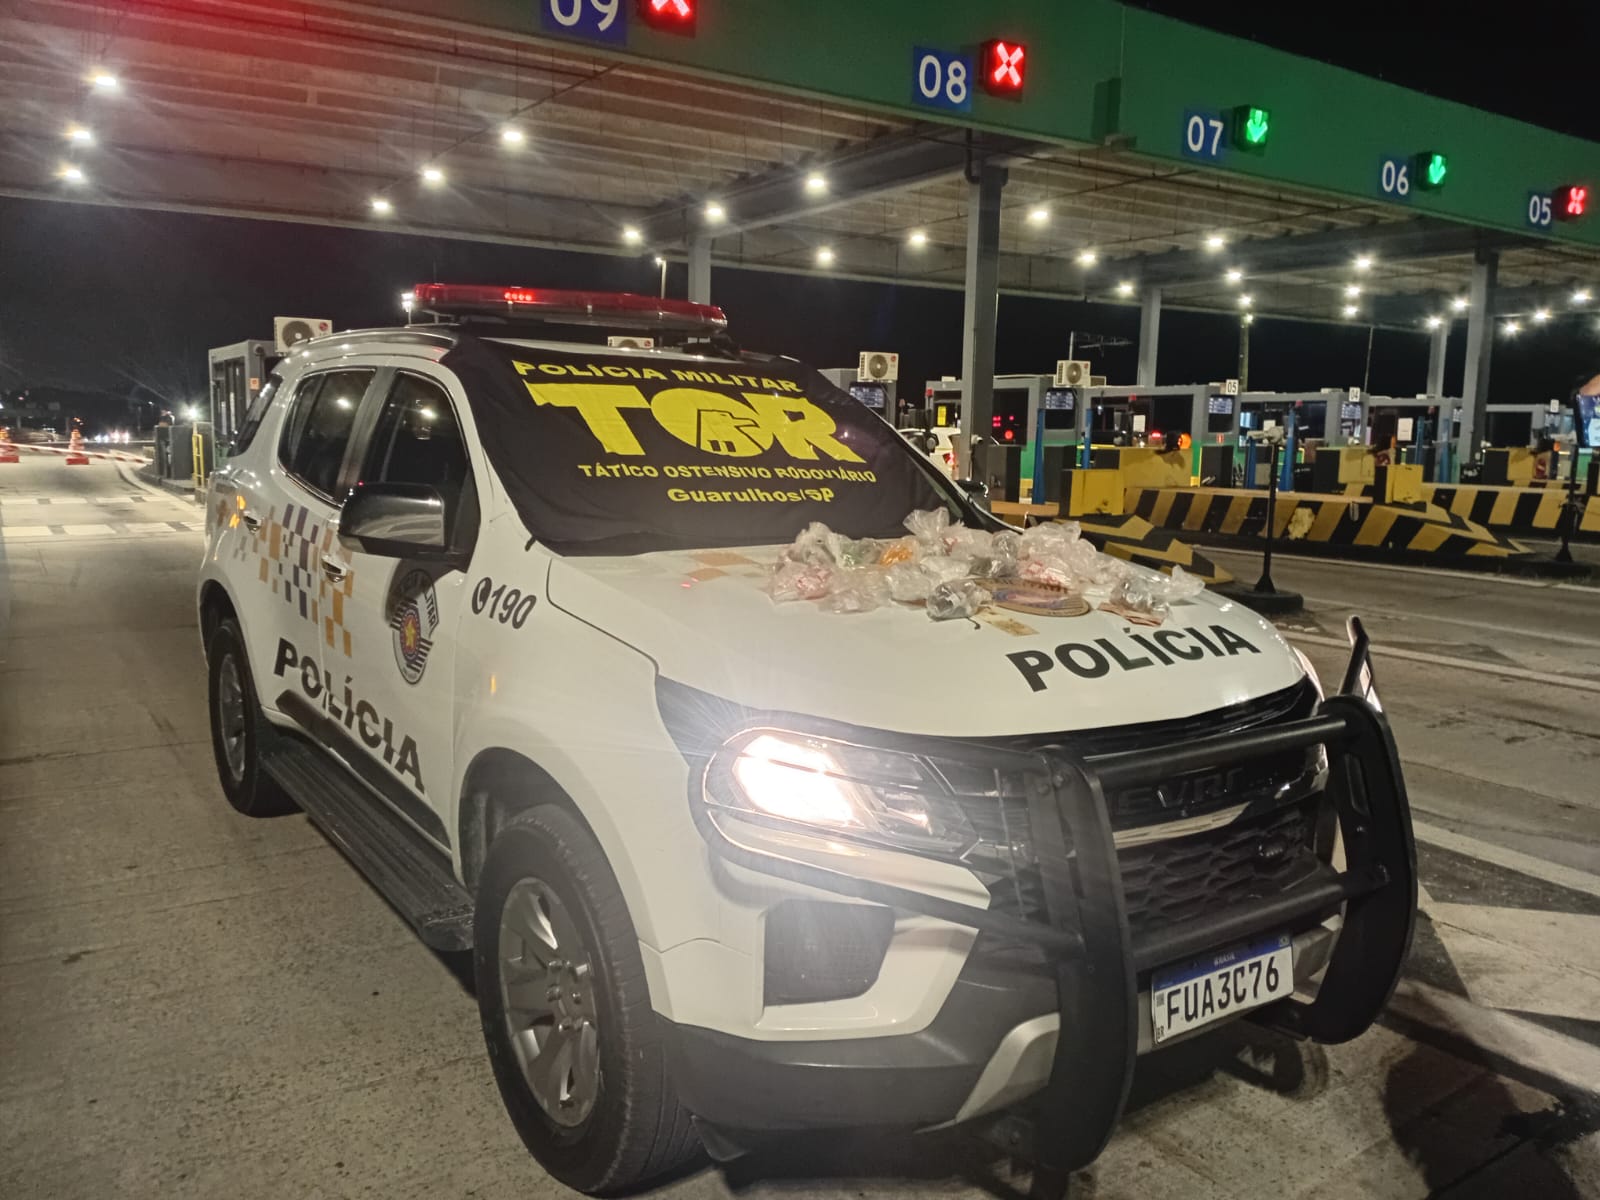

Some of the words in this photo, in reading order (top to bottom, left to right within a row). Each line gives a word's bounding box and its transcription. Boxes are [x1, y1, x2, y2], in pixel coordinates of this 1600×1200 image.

[918, 54, 967, 104] 08
[1186, 115, 1224, 156] 07
[1381, 161, 1409, 196] 06
[1528, 195, 1552, 225] 05
[512, 360, 667, 381] POLÍCIA
[670, 369, 805, 393] MILITAR
[1227, 381, 1237, 393] 05
[524, 379, 867, 464] TOR
[577, 462, 660, 479] TÁTICO
[665, 466, 772, 481] OSTENSIVO
[776, 465, 877, 483] RODOVIÁRIO
[666, 486, 835, 504] Guarulhos/SP
[488, 583, 537, 630] 190
[1005, 622, 1262, 693] POLÍCIA
[273, 637, 427, 796] POLÍCIA
[1167, 956, 1279, 1030] FUA3C76
